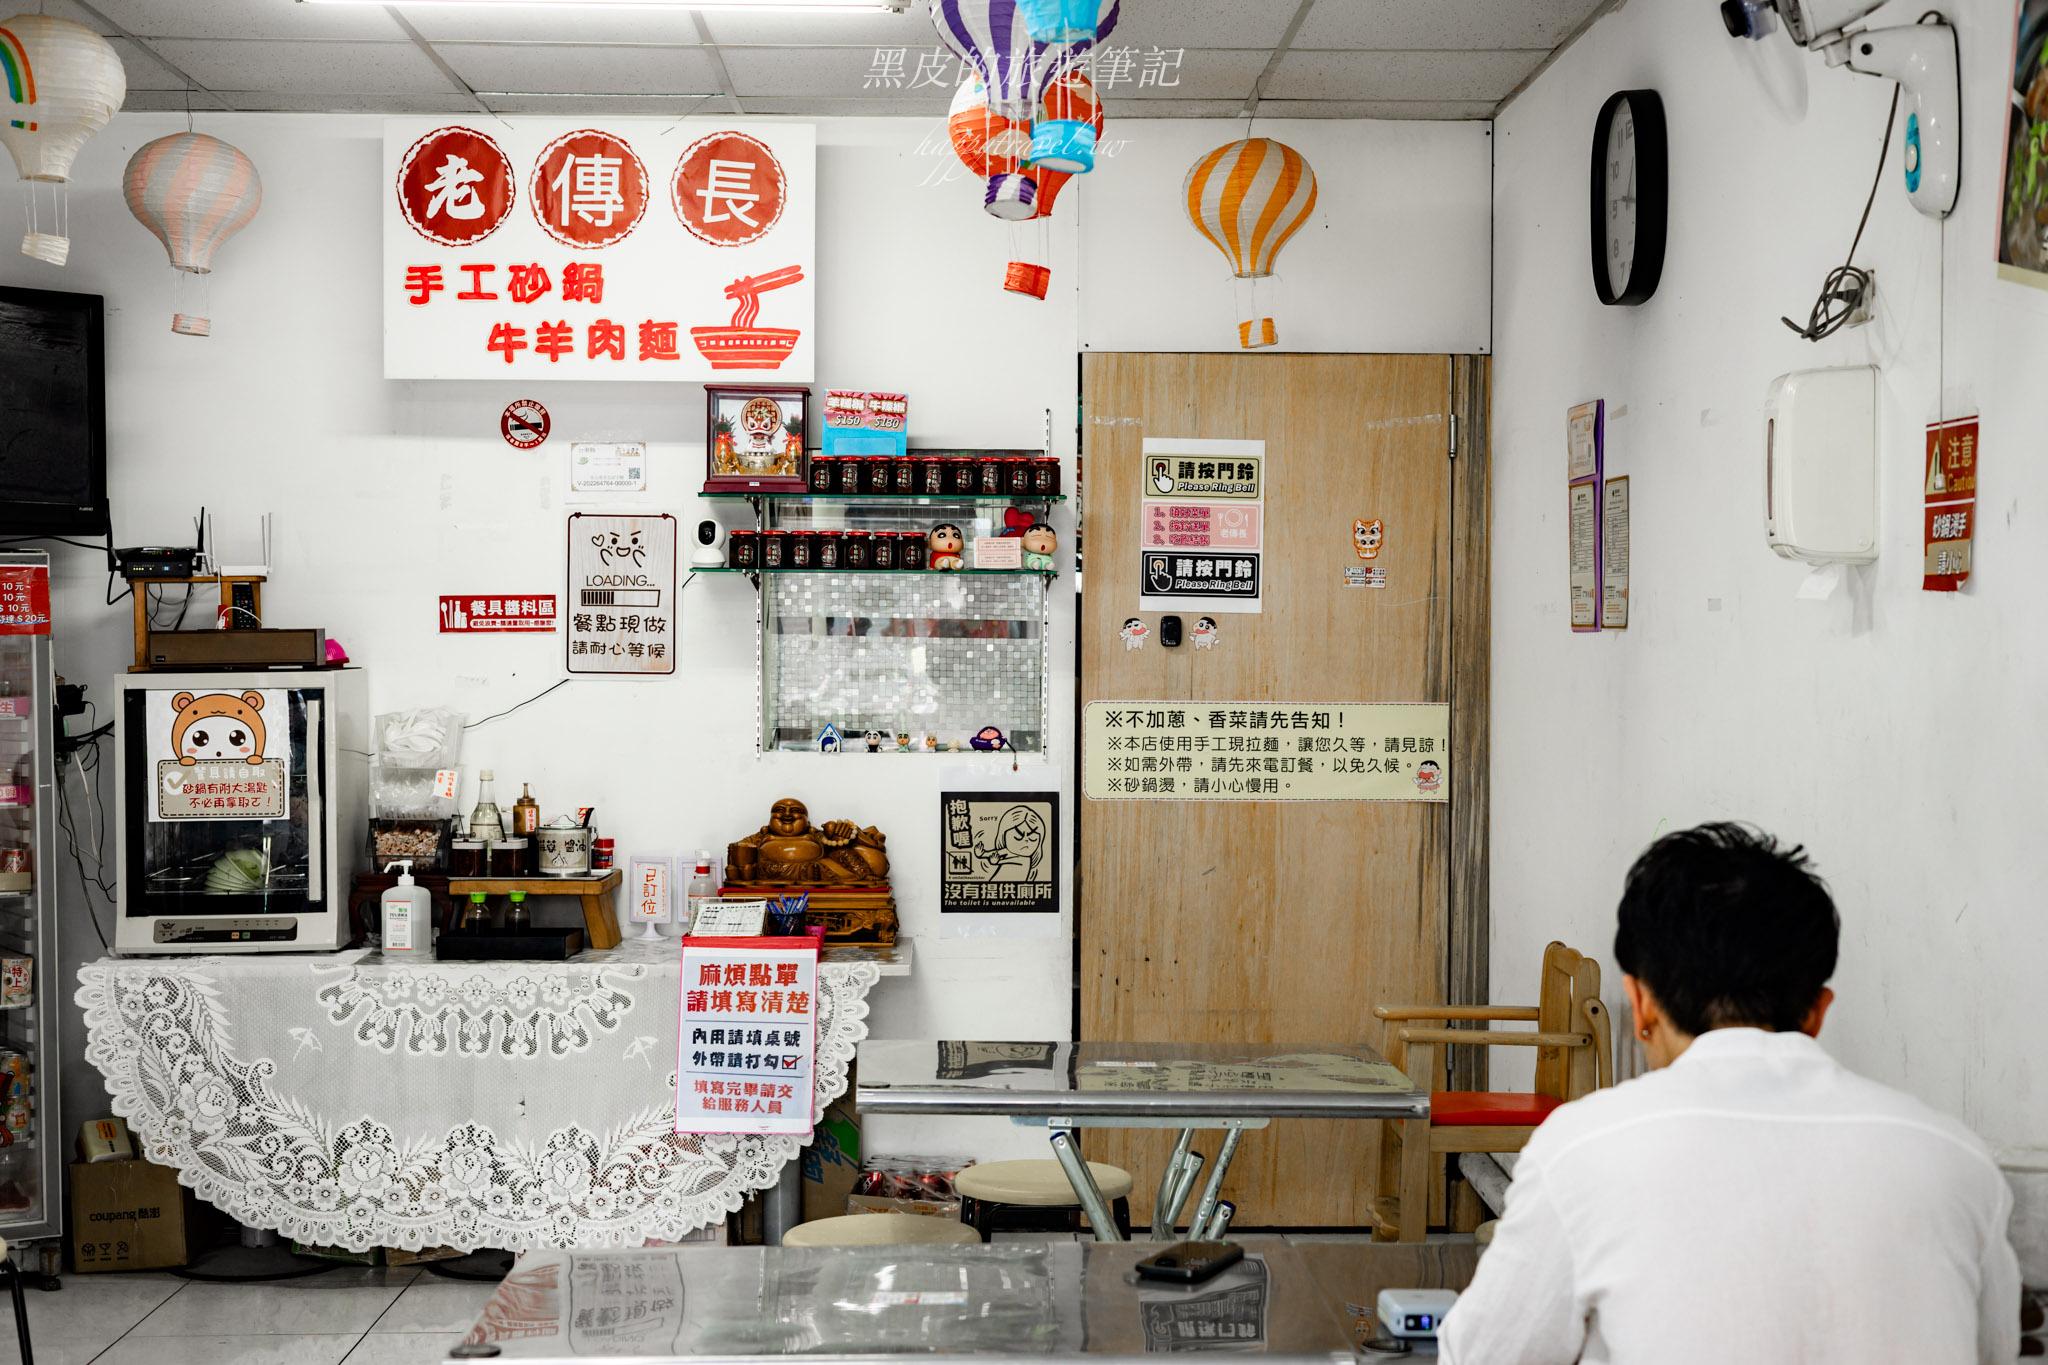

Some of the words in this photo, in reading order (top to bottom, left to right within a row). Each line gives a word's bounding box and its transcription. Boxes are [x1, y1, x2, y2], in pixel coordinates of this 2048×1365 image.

[404, 261, 605, 305] 手工砂鍋
[487, 318, 681, 363] 牛羊肉麵
[835, 414, 861, 426] $150
[1948, 433, 1974, 469] 注意
[1178, 461, 1255, 481] 請按門鈴
[1178, 482, 1209, 492] Please
[1211, 483, 1233, 494] Ring
[1234, 483, 1256, 493] Bell
[1176, 559, 1253, 579] 請按門鈴
[586, 575, 655, 588] LOADING...
[1175, 579, 1207, 589] Please
[1209, 579, 1231, 591] Ring
[1232, 580, 1253, 590] Bell
[470, 599, 555, 616] 餐具醬料區
[573, 613, 667, 634] 餐點現做
[572, 640, 666, 659] 請耐心等候
[641, 867, 658, 915] 已訂位
[944, 883, 1052, 899] 沒有提供廁所
[699, 963, 799, 987] 麻煩點單
[687, 990, 810, 1014] 請填寫清楚
[692, 1028, 800, 1047] 內用請填桌號
[692, 1051, 779, 1070] 外帶請打勾
[694, 1079, 794, 1099] 填寫完畢請交
[702, 1096, 783, 1114] 給服務人員
[89, 1209, 136, 1223] coupang
